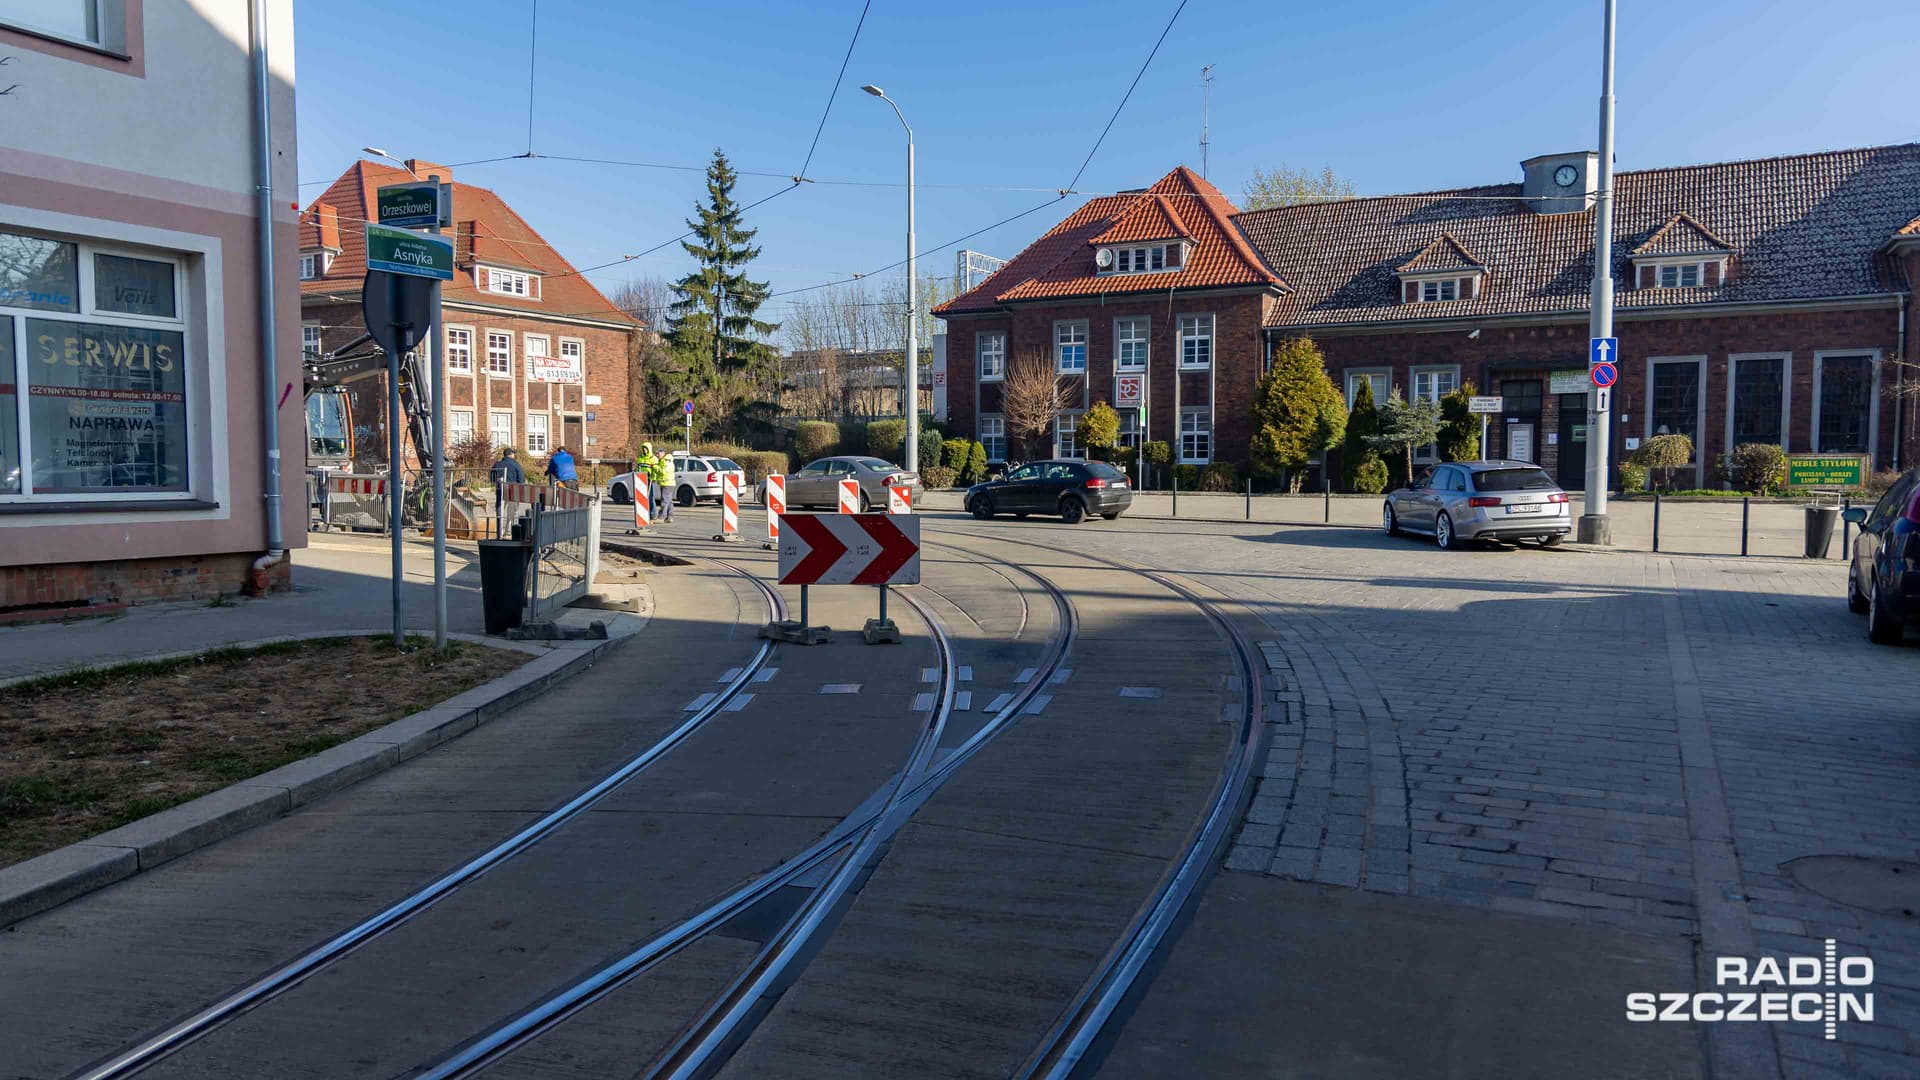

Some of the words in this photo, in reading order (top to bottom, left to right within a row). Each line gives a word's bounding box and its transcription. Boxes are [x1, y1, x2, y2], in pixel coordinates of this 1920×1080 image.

[382, 200, 432, 217] Orzeszkowej
[393, 247, 433, 265] Asnyka
[38, 334, 174, 373] SERWIS
[69, 416, 155, 431] NAPRAWA
[1791, 460, 1818, 468] MEBLE
[1820, 460, 1859, 468] STYLOWE
